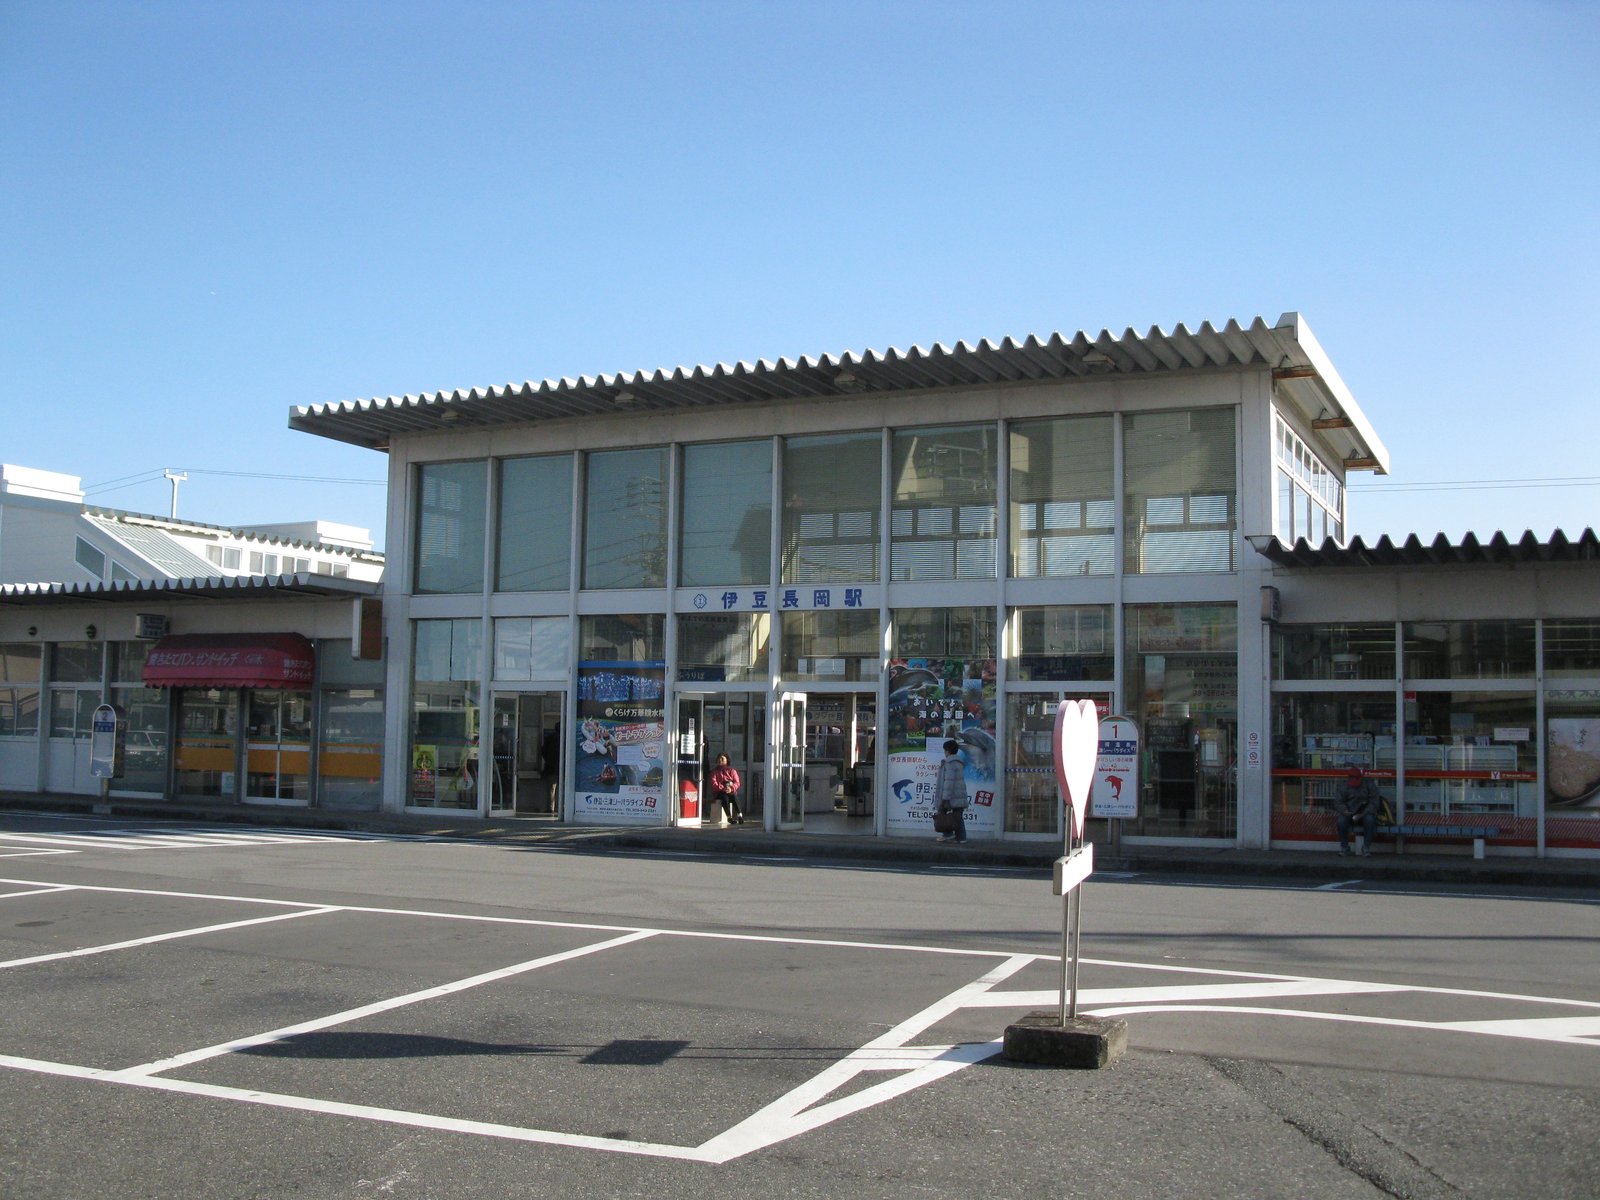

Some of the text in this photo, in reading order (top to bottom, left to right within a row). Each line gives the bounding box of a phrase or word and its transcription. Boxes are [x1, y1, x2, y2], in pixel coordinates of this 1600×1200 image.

[721, 589, 862, 609] 伊豆長岡駅
[1112, 724, 1118, 738] 1
